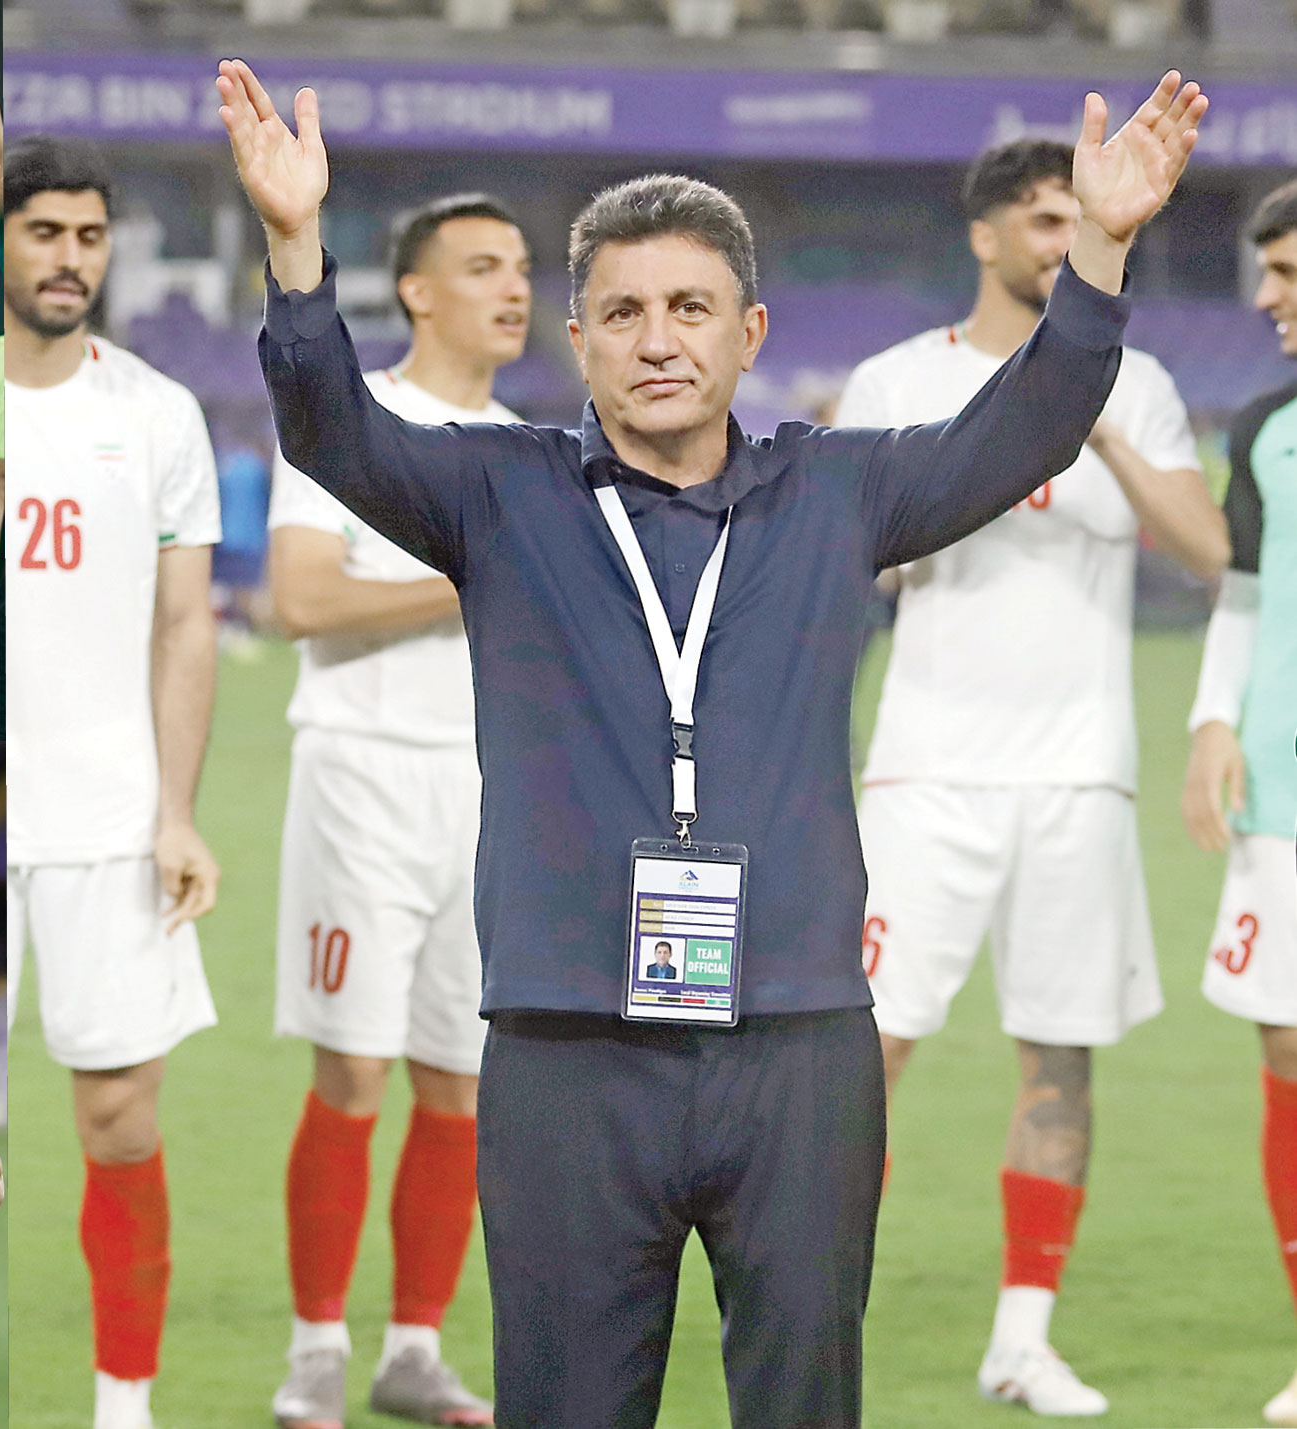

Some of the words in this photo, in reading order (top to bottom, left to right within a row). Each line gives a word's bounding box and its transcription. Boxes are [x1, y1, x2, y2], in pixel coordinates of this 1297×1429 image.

[98, 76, 190, 130] BIN
[381, 81, 613, 137] STADIUM
[18, 497, 81, 571] 26
[308, 922, 351, 994] 10
[687, 961, 729, 975] OFFICIAL
[696, 947, 722, 960] TEAM
